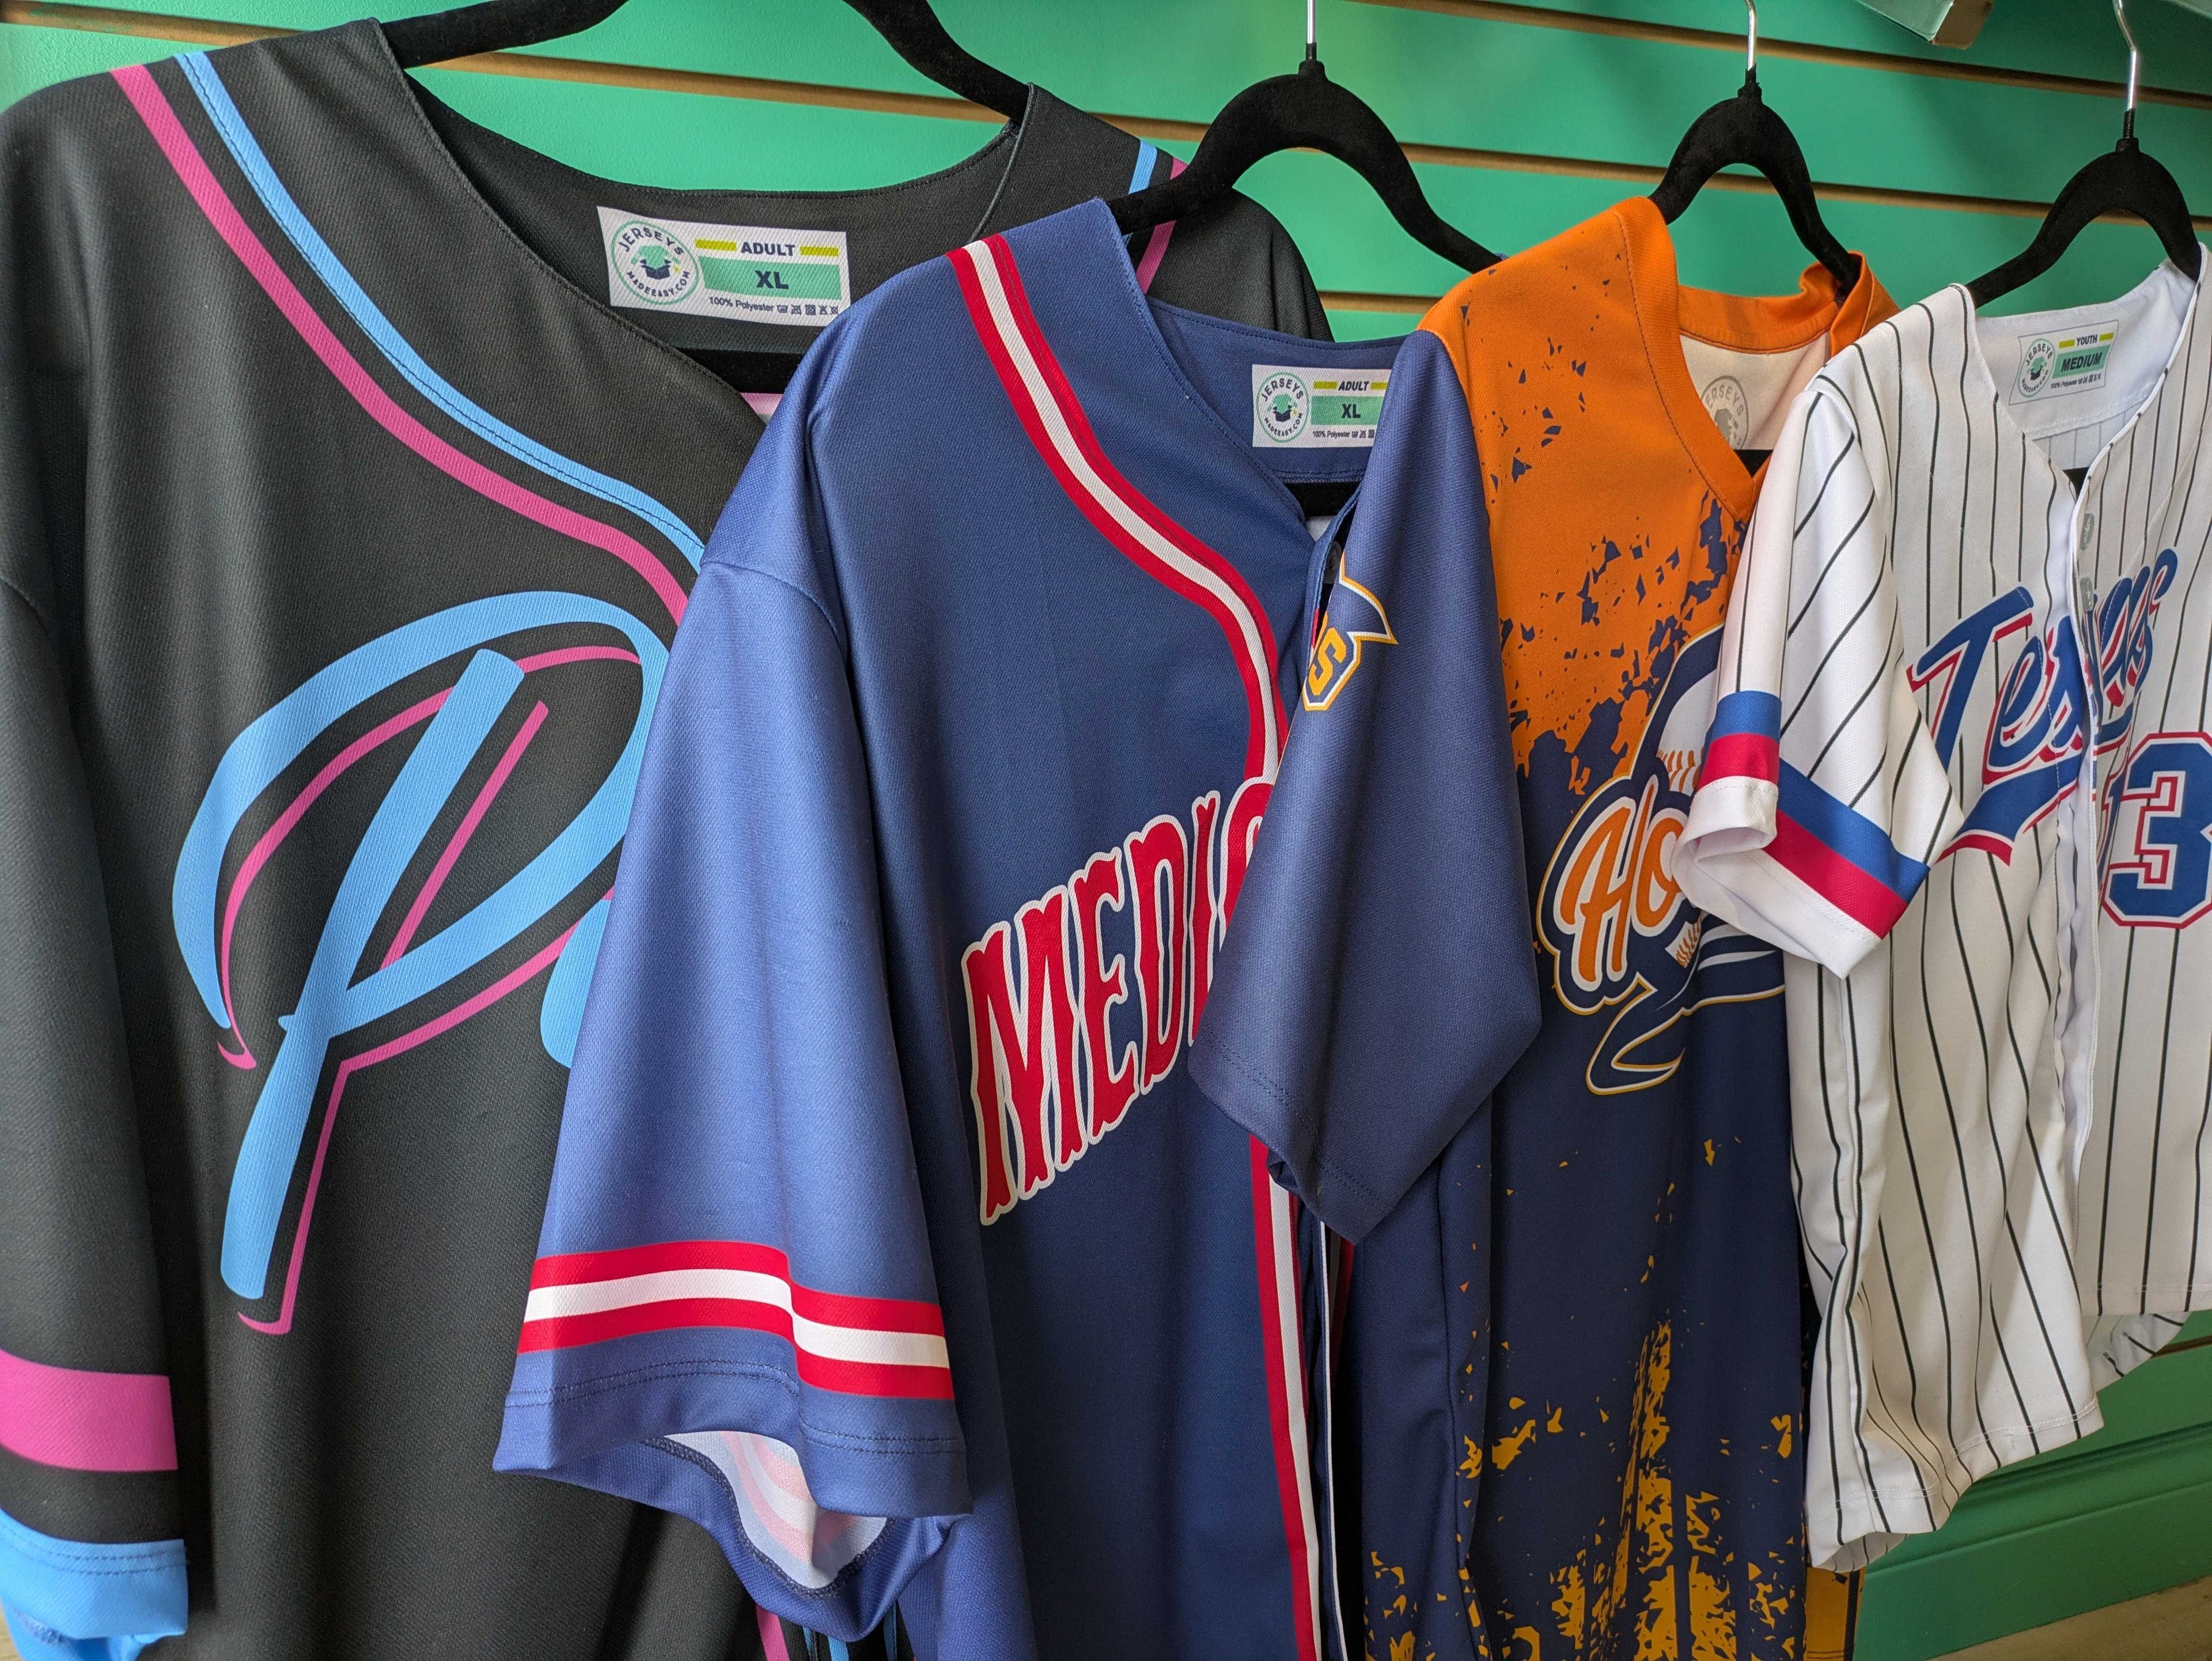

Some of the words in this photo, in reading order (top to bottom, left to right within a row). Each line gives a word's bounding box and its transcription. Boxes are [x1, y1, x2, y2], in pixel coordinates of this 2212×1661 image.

[618, 227, 684, 255] JERSEYS
[741, 242, 796, 256] ADULT
[627, 271, 690, 297] MADEEASY.COM
[755, 270, 789, 289] XL
[709, 297, 733, 307] 100%
[736, 300, 774, 312] Polyester
[2076, 334, 2098, 346] YOUTH
[2026, 343, 2052, 366] JERSEYS
[2061, 352, 2103, 372] MEDIUM
[1262, 378, 1303, 402] JERSEYS
[1338, 381, 1369, 391] ADULT
[1705, 384, 1744, 416] ERSEYS
[1342, 404, 1361, 418] XL
[1327, 430, 1350, 438] Polyester
[172, 590, 671, 1335] P
